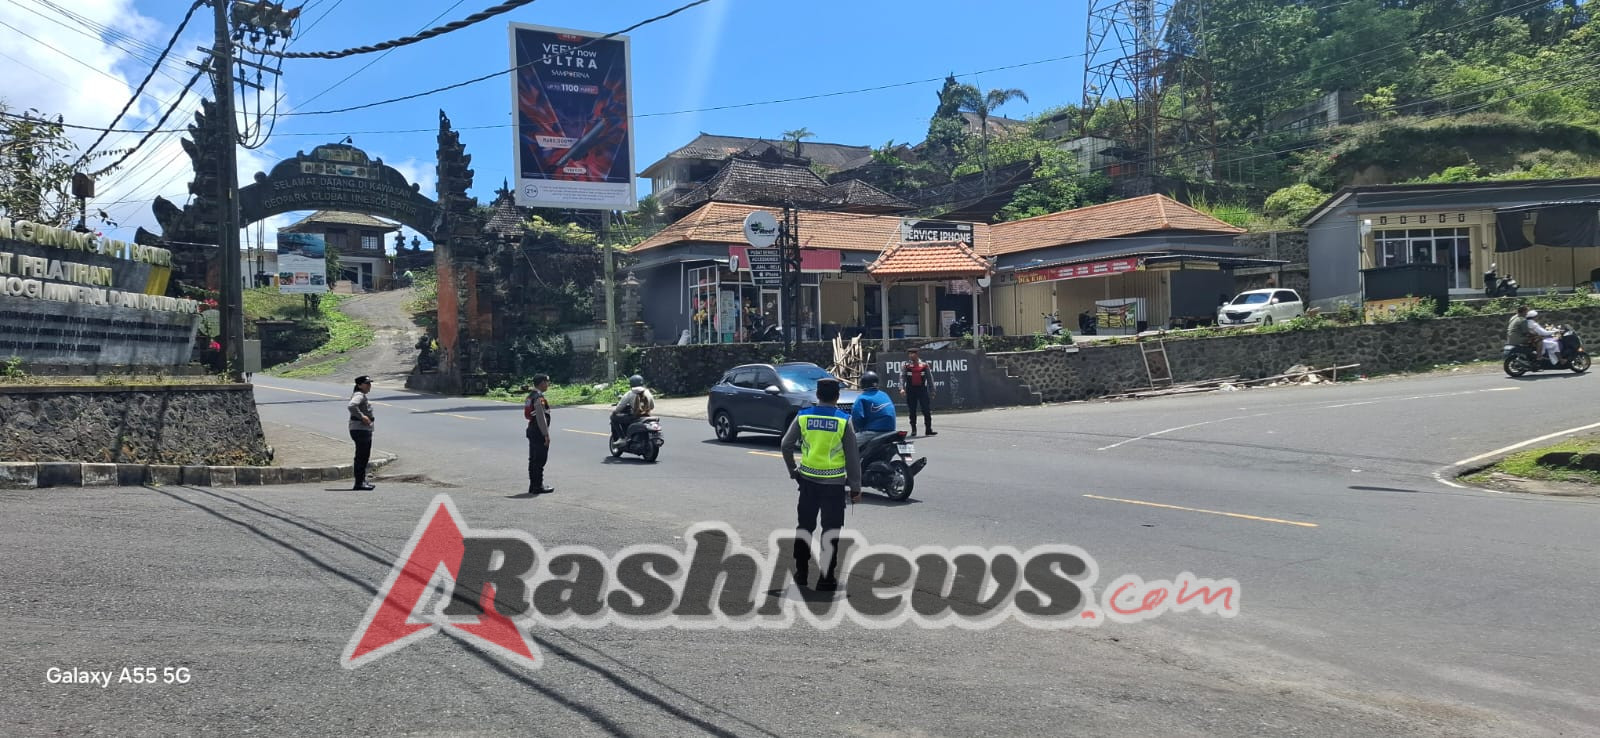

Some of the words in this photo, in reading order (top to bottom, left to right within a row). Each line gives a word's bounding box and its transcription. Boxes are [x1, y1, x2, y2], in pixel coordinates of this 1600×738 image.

[542, 54, 598, 70] ULTRA
[561, 83, 579, 92] 1100
[273, 177, 316, 190] SELAMAT
[320, 177, 355, 187] DATANG
[358, 180, 367, 188] DI
[370, 180, 412, 198] KAWASAN
[264, 192, 308, 209] GEOPARK
[311, 192, 347, 201] GLOBAL
[351, 194, 387, 207] UNESCO
[15, 220, 99, 253] GUNUNG
[101, 237, 131, 260] API
[132, 242, 172, 266] BATUR
[940, 231, 972, 243] IPHONE
[43, 281, 108, 305] MINERAL
[109, 290, 142, 310] DAN
[807, 419, 838, 431] POLISI
